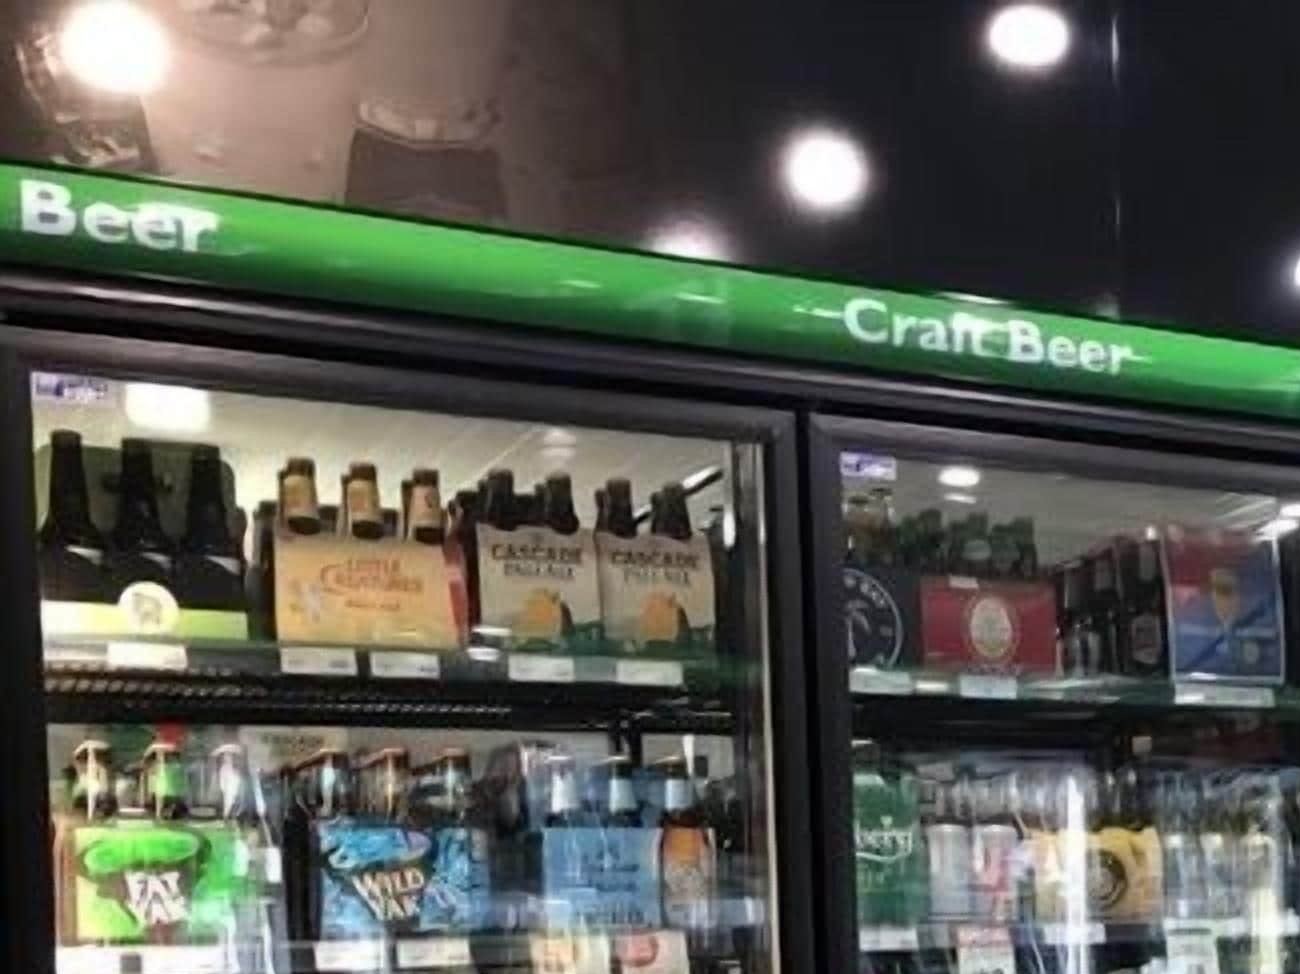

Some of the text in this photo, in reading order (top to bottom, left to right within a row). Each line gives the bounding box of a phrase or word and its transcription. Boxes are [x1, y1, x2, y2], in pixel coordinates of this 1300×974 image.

[20, 178, 222, 253] Beer
[843, 297, 1132, 377] Craft Beer
[124, 871, 182, 900] FAT
[352, 867, 426, 903] WILD
[132, 893, 190, 927] YAK
[375, 892, 422, 924] YAK
